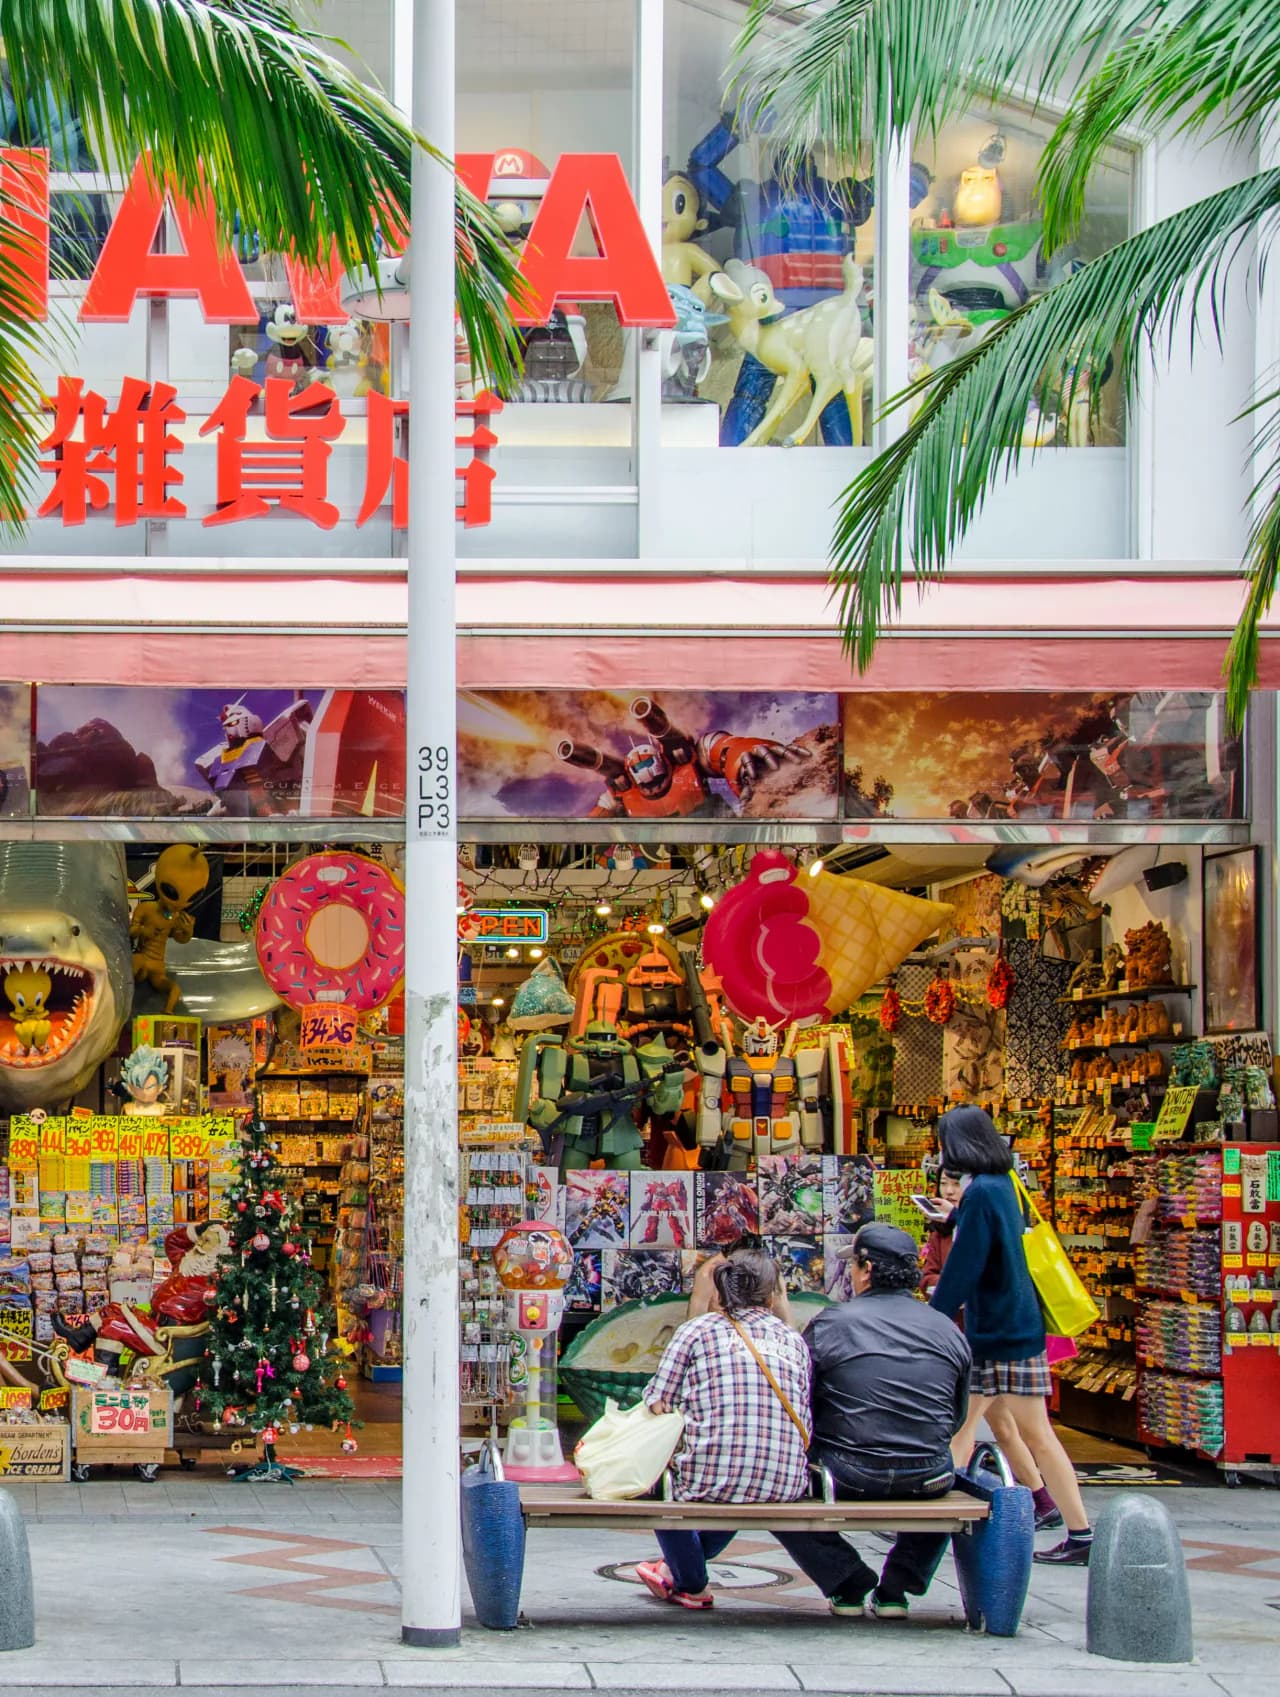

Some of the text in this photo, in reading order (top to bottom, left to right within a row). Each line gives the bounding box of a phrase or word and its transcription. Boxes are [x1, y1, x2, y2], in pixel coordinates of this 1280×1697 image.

[417, 746, 449, 772] 39
[264, 780, 343, 790] GUNM
[418, 774, 449, 800] L3
[417, 803, 450, 829] P3
[875, 1170, 923, 1184] アルバイト
[881, 1181, 913, 1196] 募集中
[10, 1443, 60, 1461] Borden's
[7, 1464, 61, 1475] ICE CREAM
